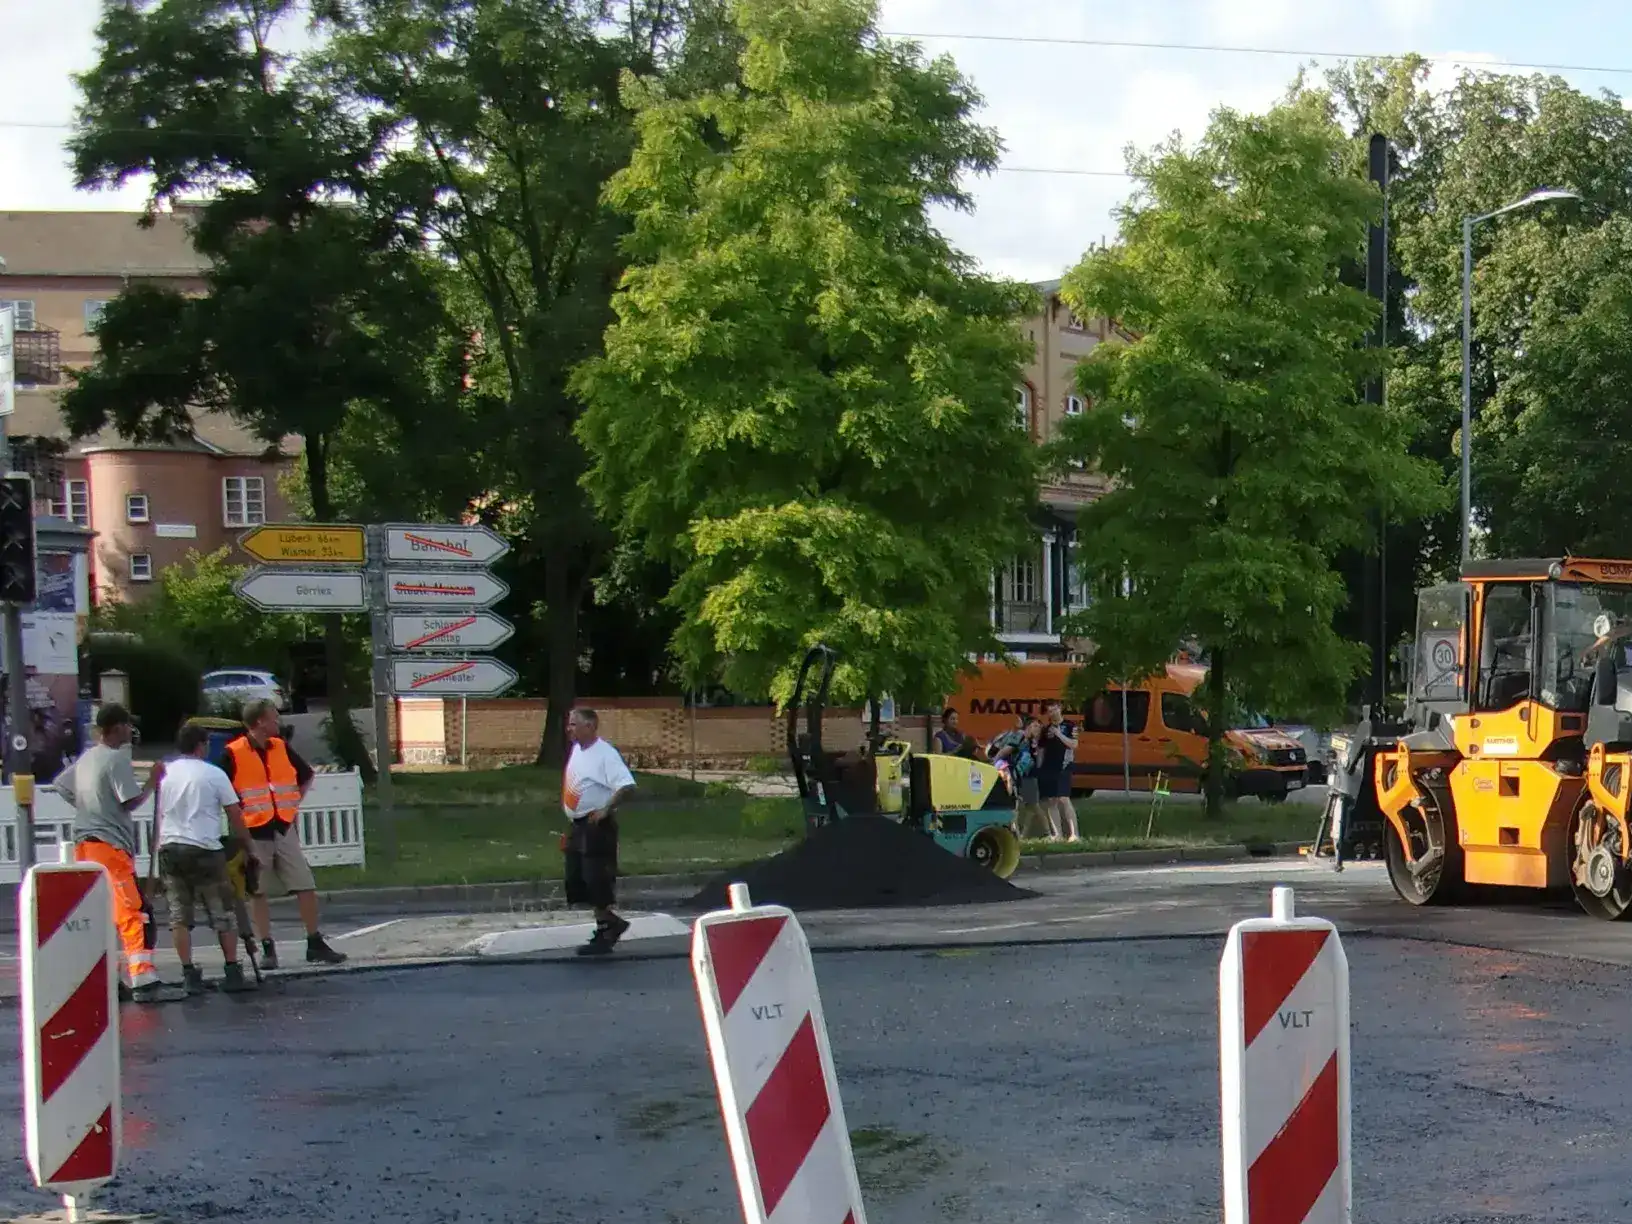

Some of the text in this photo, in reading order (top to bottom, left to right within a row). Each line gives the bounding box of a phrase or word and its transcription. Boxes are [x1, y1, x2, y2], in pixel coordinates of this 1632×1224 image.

[281, 547, 316, 557] Wismar
[296, 585, 332, 596] Görries
[422, 632, 461, 643] Lndtag
[1436, 649, 1451, 664] 30
[412, 671, 475, 682] Staatheater
[751, 1003, 784, 1020] VLT
[1278, 1010, 1313, 1030] VLT
